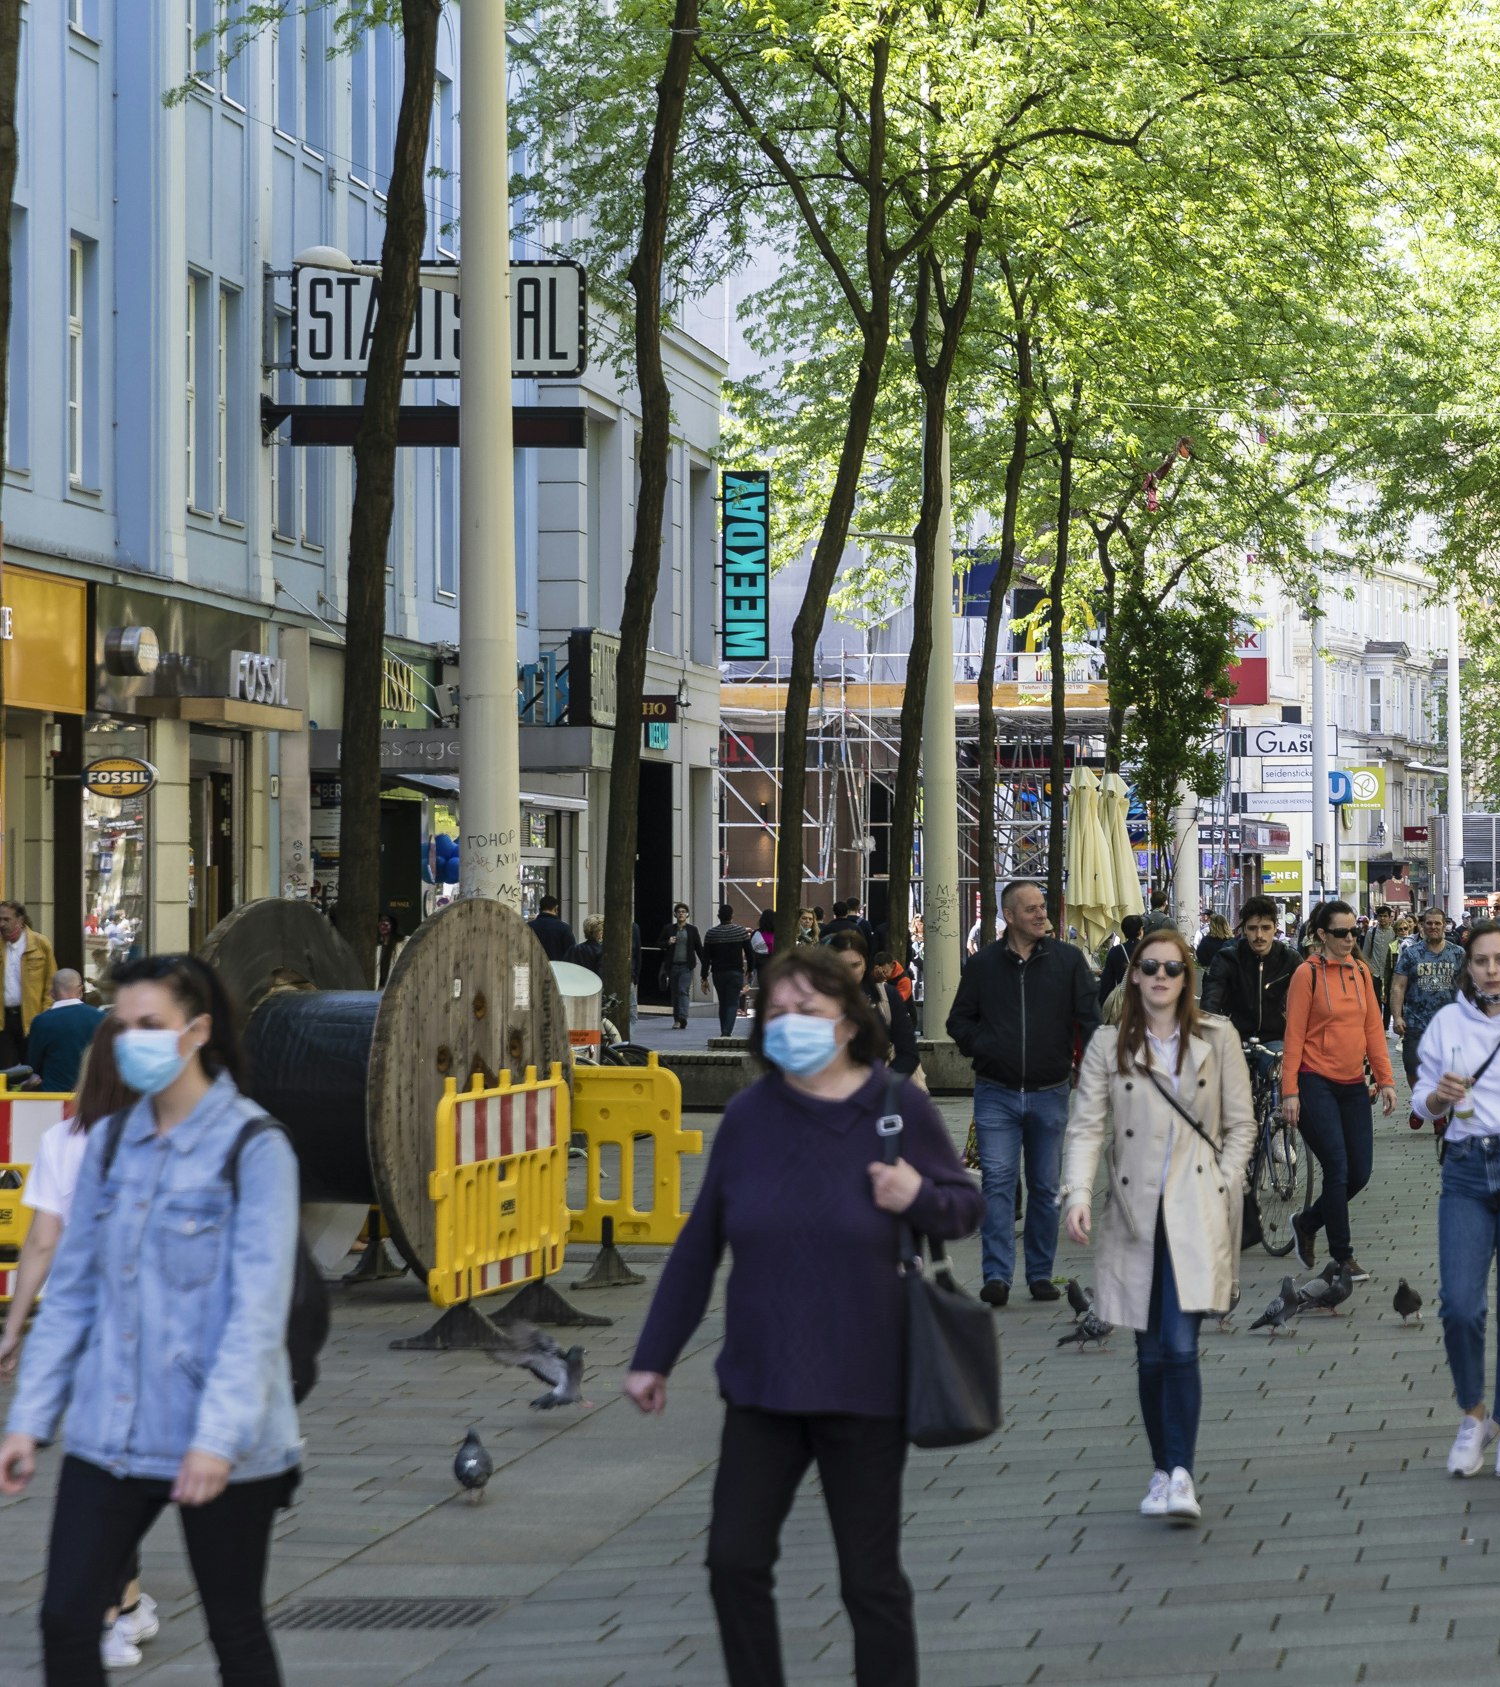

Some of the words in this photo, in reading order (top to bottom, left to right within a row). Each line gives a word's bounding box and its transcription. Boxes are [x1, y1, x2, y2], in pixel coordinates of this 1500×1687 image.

[724, 474, 766, 658] WEEKDAY
[229, 650, 289, 706] FOSSIL
[1255, 730, 1313, 753] GLAS
[87, 771, 149, 784] FOSSIL
